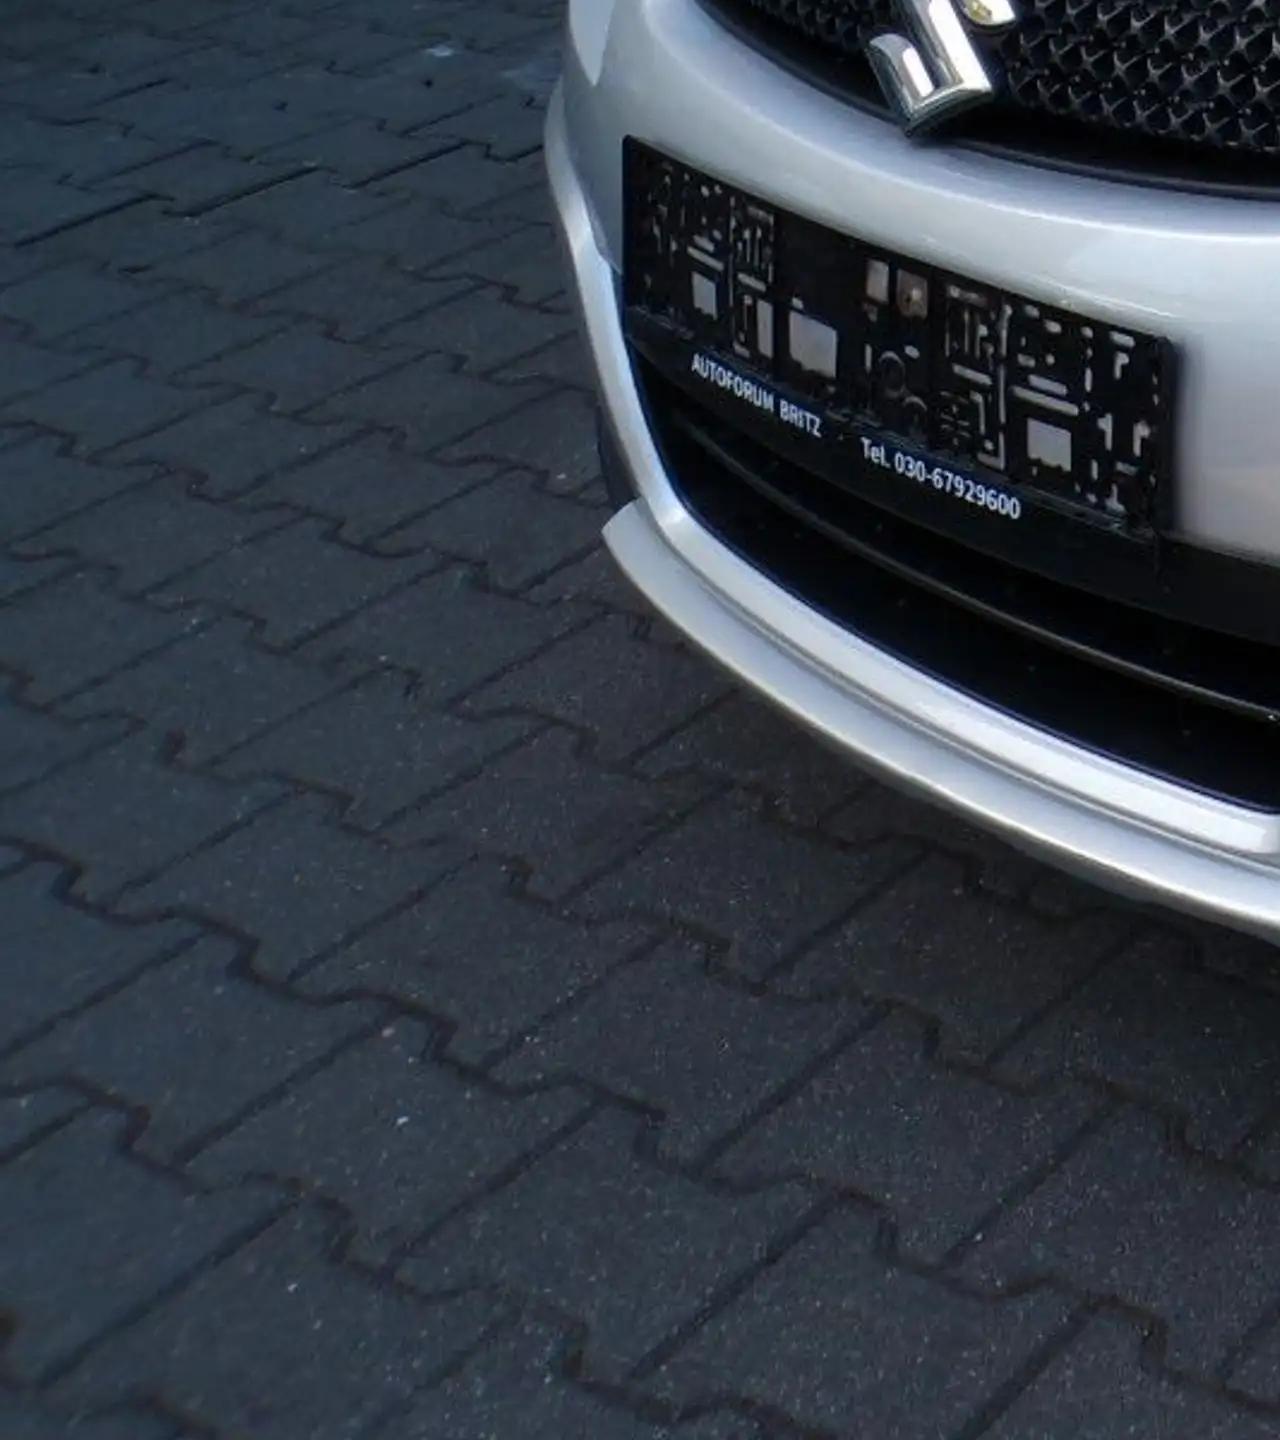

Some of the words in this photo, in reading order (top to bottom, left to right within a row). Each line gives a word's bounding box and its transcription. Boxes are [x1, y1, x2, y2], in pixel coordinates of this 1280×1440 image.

[691, 352, 775, 413] AUTOFORUM
[779, 398, 822, 439] BRITZ
[860, 436, 891, 469] Tel.
[894, 451, 1022, 520] 030-67929600
